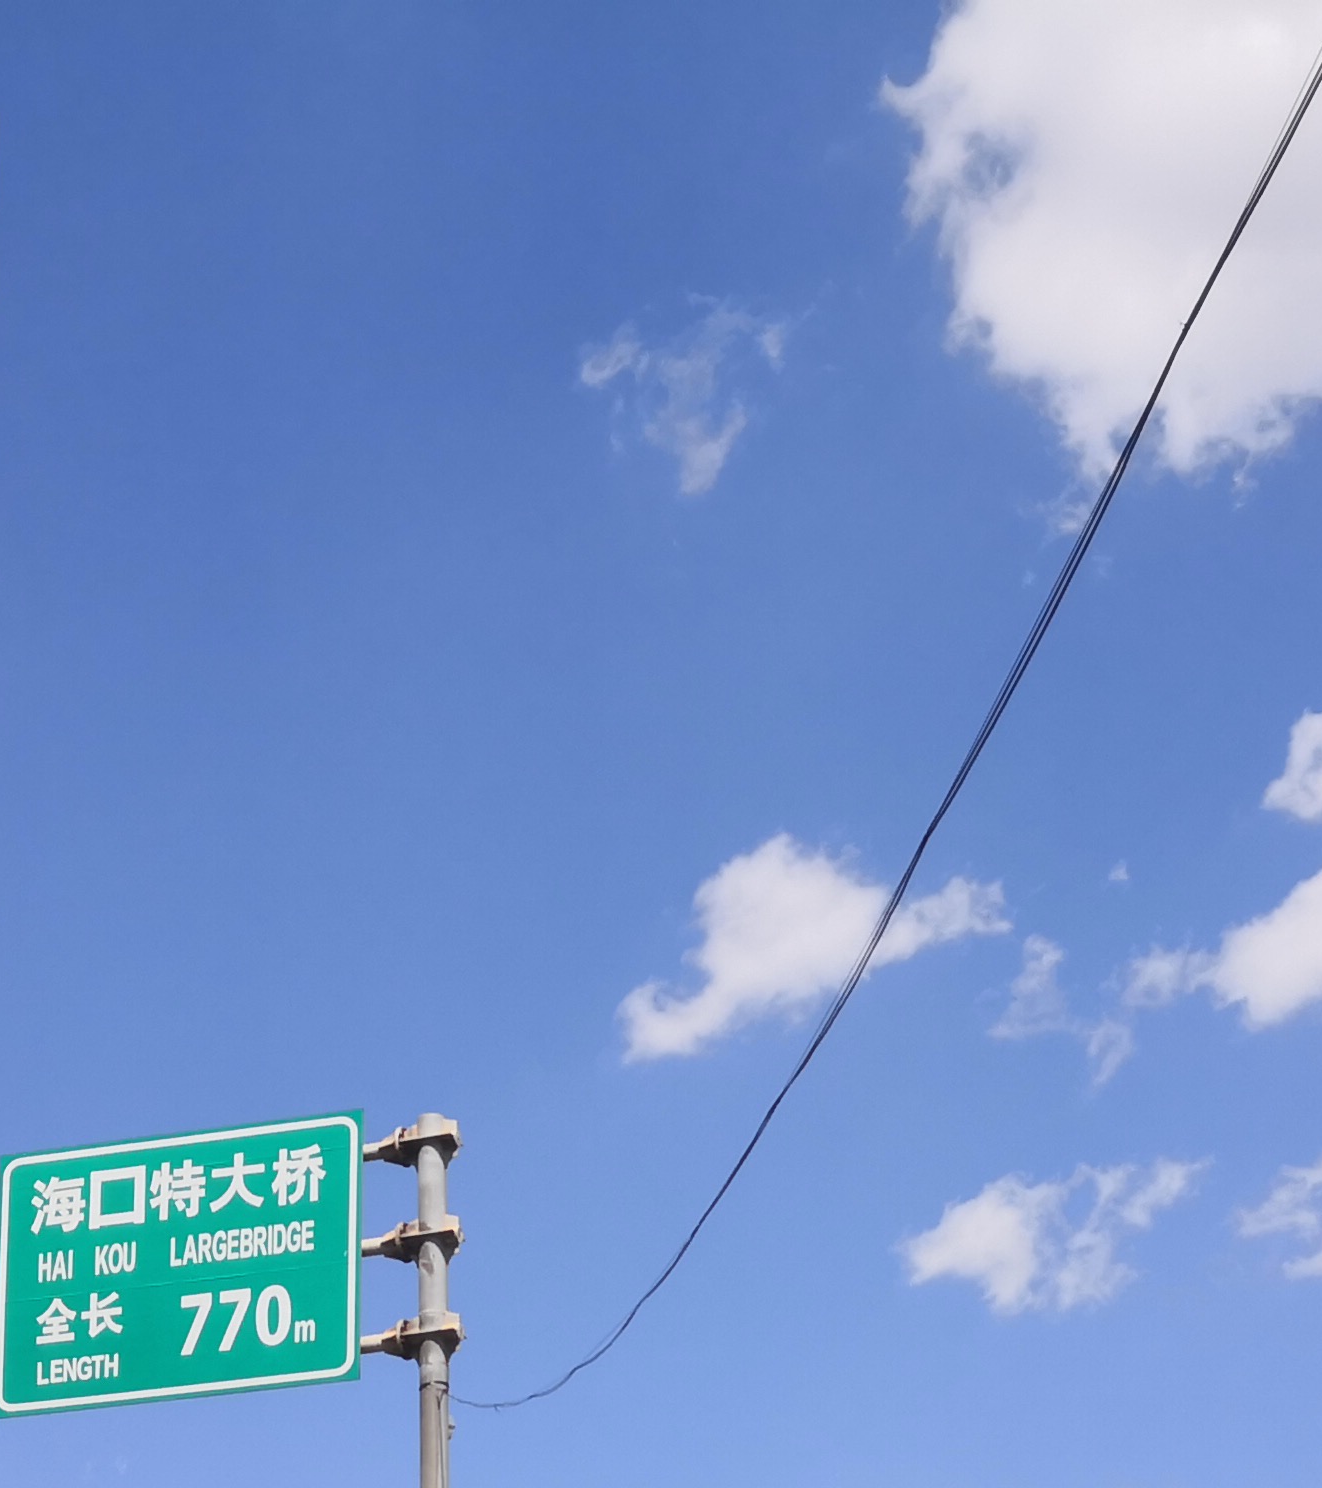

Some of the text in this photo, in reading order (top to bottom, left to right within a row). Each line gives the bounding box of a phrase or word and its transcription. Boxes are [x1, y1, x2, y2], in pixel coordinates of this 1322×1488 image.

[30, 1143, 327, 1235] 海口特大桥
[37, 1220, 316, 1283] HAI KOU LARGEBRIDGE
[36, 1284, 316, 1357] 全长 770m
[36, 1353, 120, 1386] LENGTH
